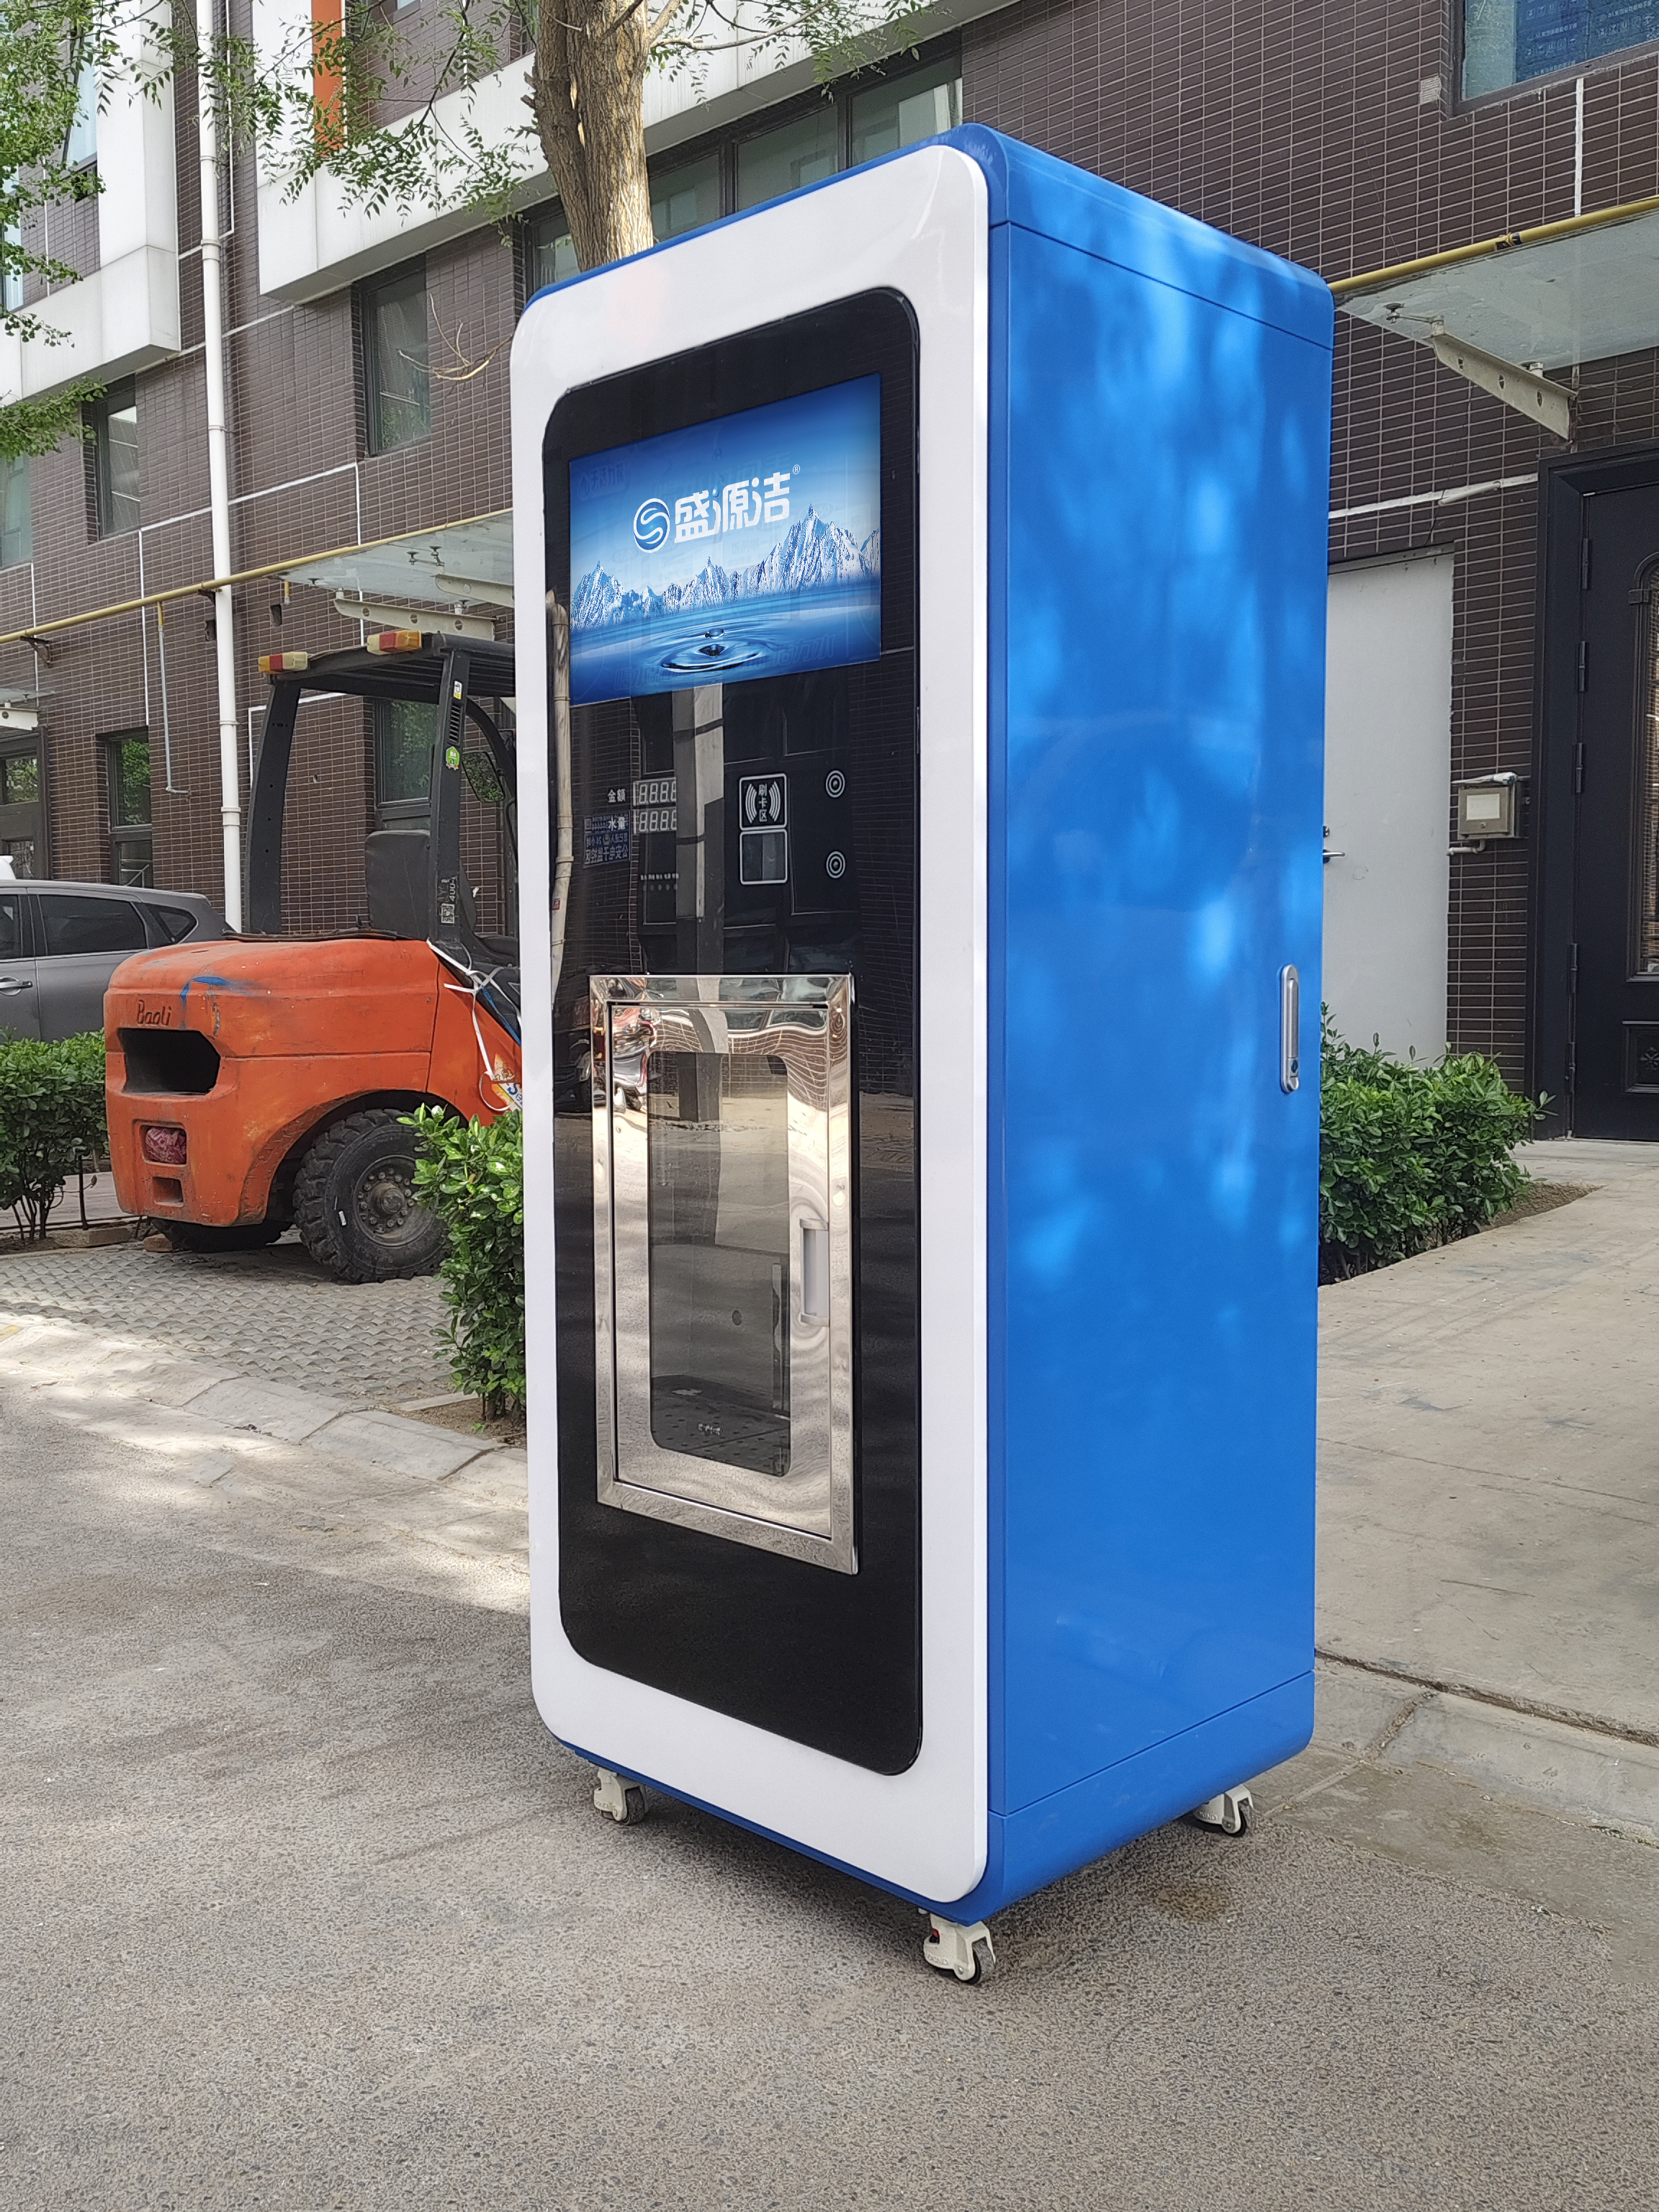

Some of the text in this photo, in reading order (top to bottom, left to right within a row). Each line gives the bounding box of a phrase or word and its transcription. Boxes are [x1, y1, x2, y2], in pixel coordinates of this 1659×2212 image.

[674, 472, 791, 544] 盛源洁
[607, 788, 626, 803] 金额
[757, 783, 768, 822] 刷卡区
[608, 815, 626, 831] 水量
